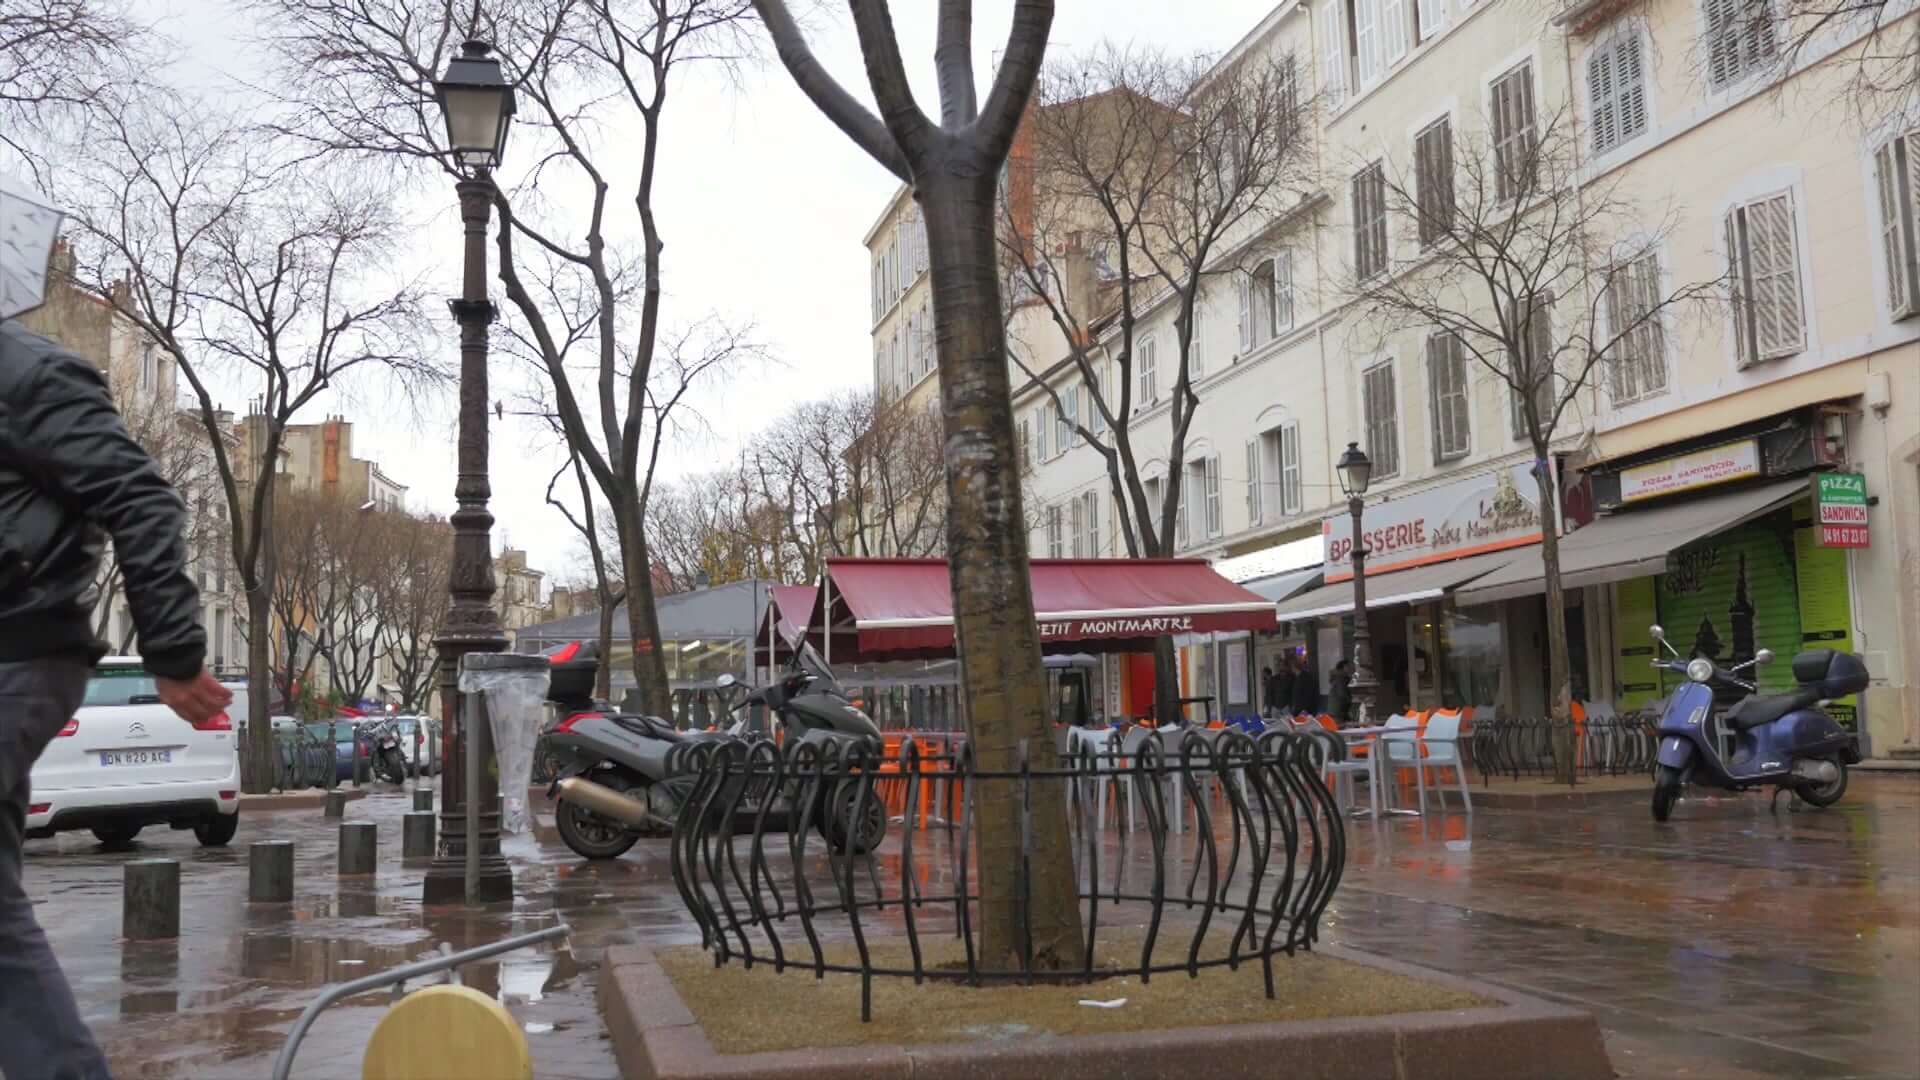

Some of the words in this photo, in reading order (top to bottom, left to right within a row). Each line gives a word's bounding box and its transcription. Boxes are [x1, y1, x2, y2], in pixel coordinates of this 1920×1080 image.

[1821, 477, 1862, 492] PIZZA
[1823, 506, 1866, 521] SANDWICH
[1330, 518, 1426, 561] BRSSERIE
[1037, 622, 1072, 636] ETIT
[1080, 616, 1193, 634] MONTMARTRE
